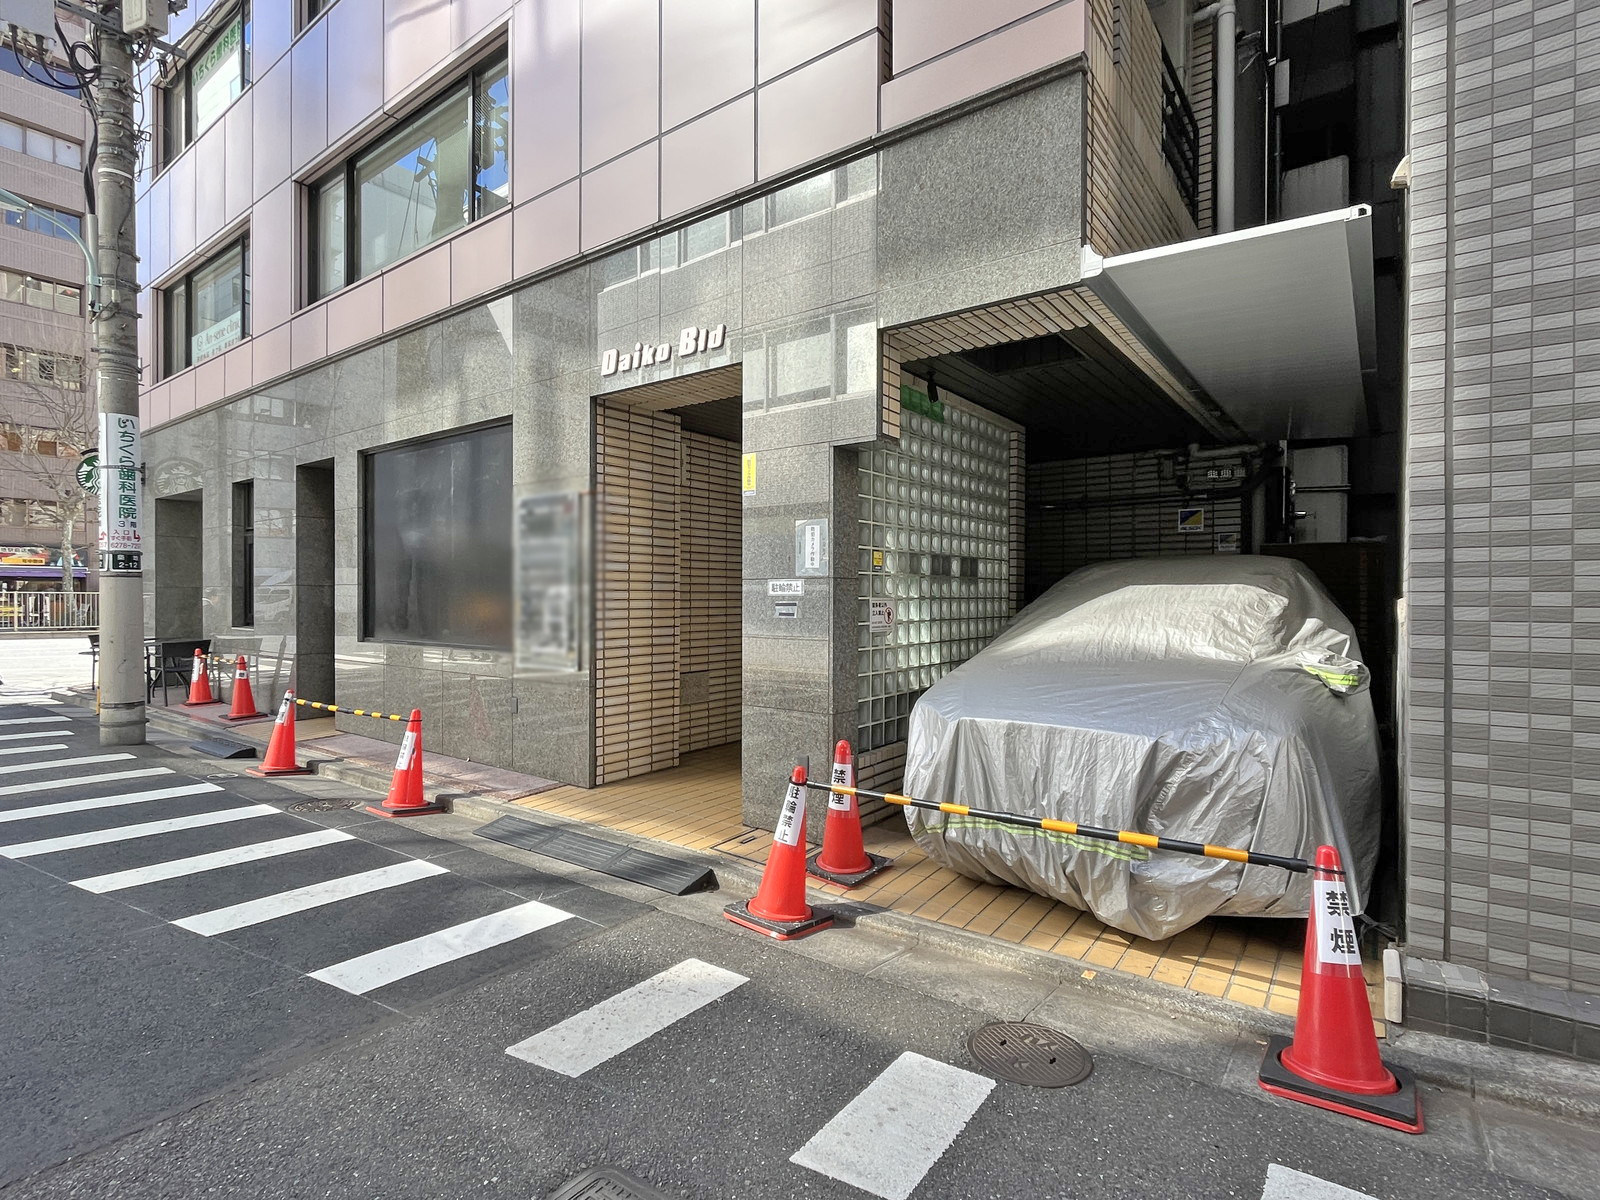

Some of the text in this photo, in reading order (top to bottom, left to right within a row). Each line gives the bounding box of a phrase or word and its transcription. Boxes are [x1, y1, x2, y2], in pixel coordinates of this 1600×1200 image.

[601, 324, 727, 376] Daiko Bld
[117, 416, 138, 519] いちくら歯科医院
[771, 582, 801, 593] 駐輪禁止
[1326, 890, 1356, 955] 禁煙
